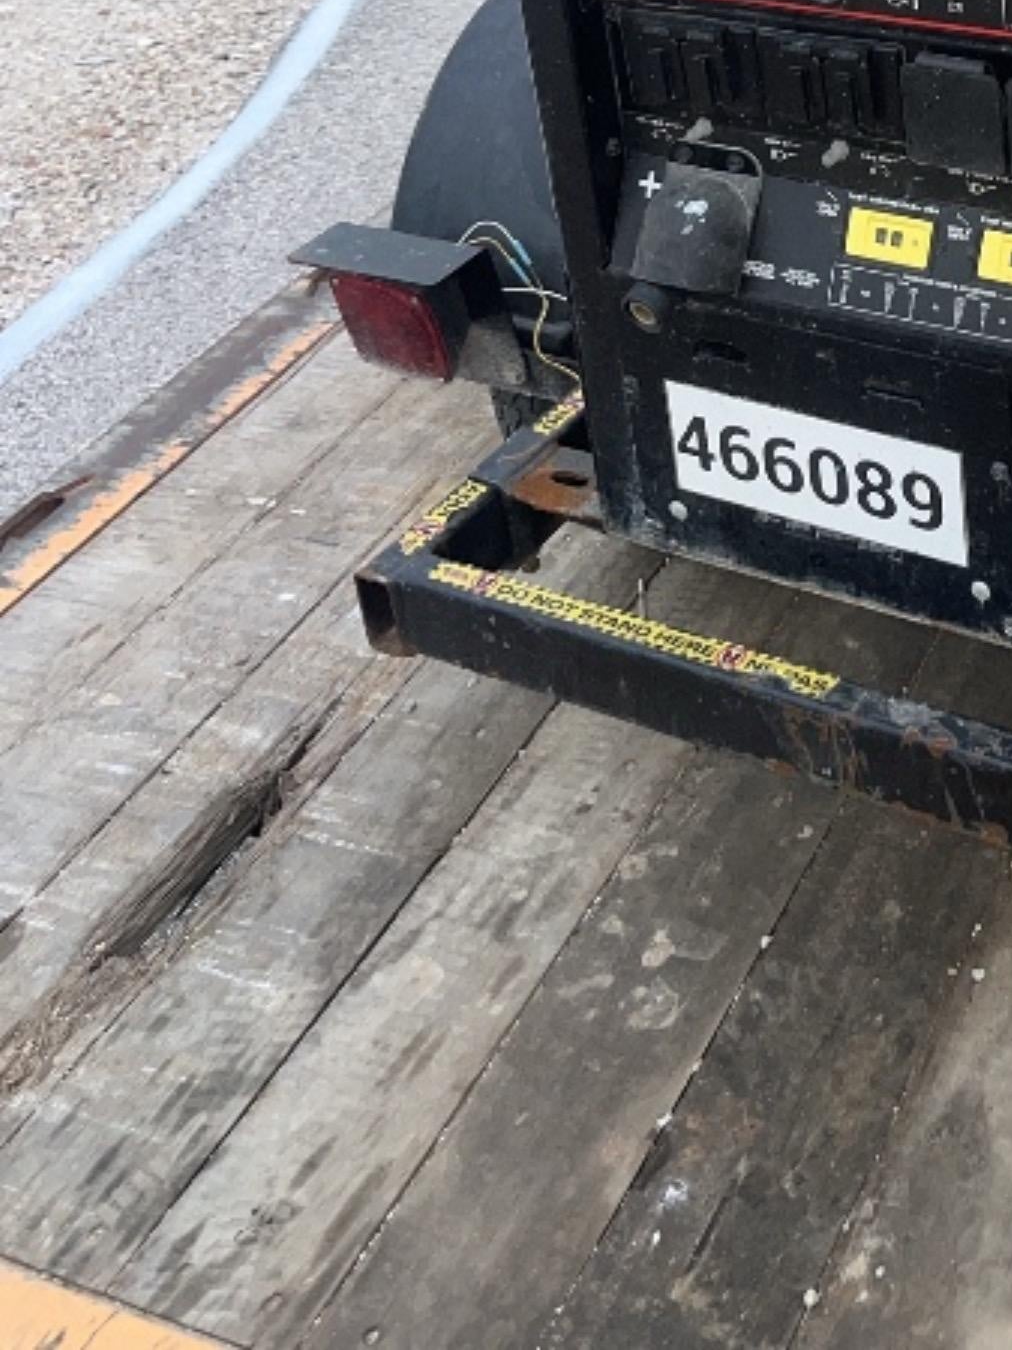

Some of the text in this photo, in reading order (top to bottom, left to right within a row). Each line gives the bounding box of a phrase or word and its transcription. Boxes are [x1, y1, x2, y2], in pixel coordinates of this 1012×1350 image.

[677, 416, 944, 531] 466089
[497, 584, 716, 658] DO NOT STAND HERE
